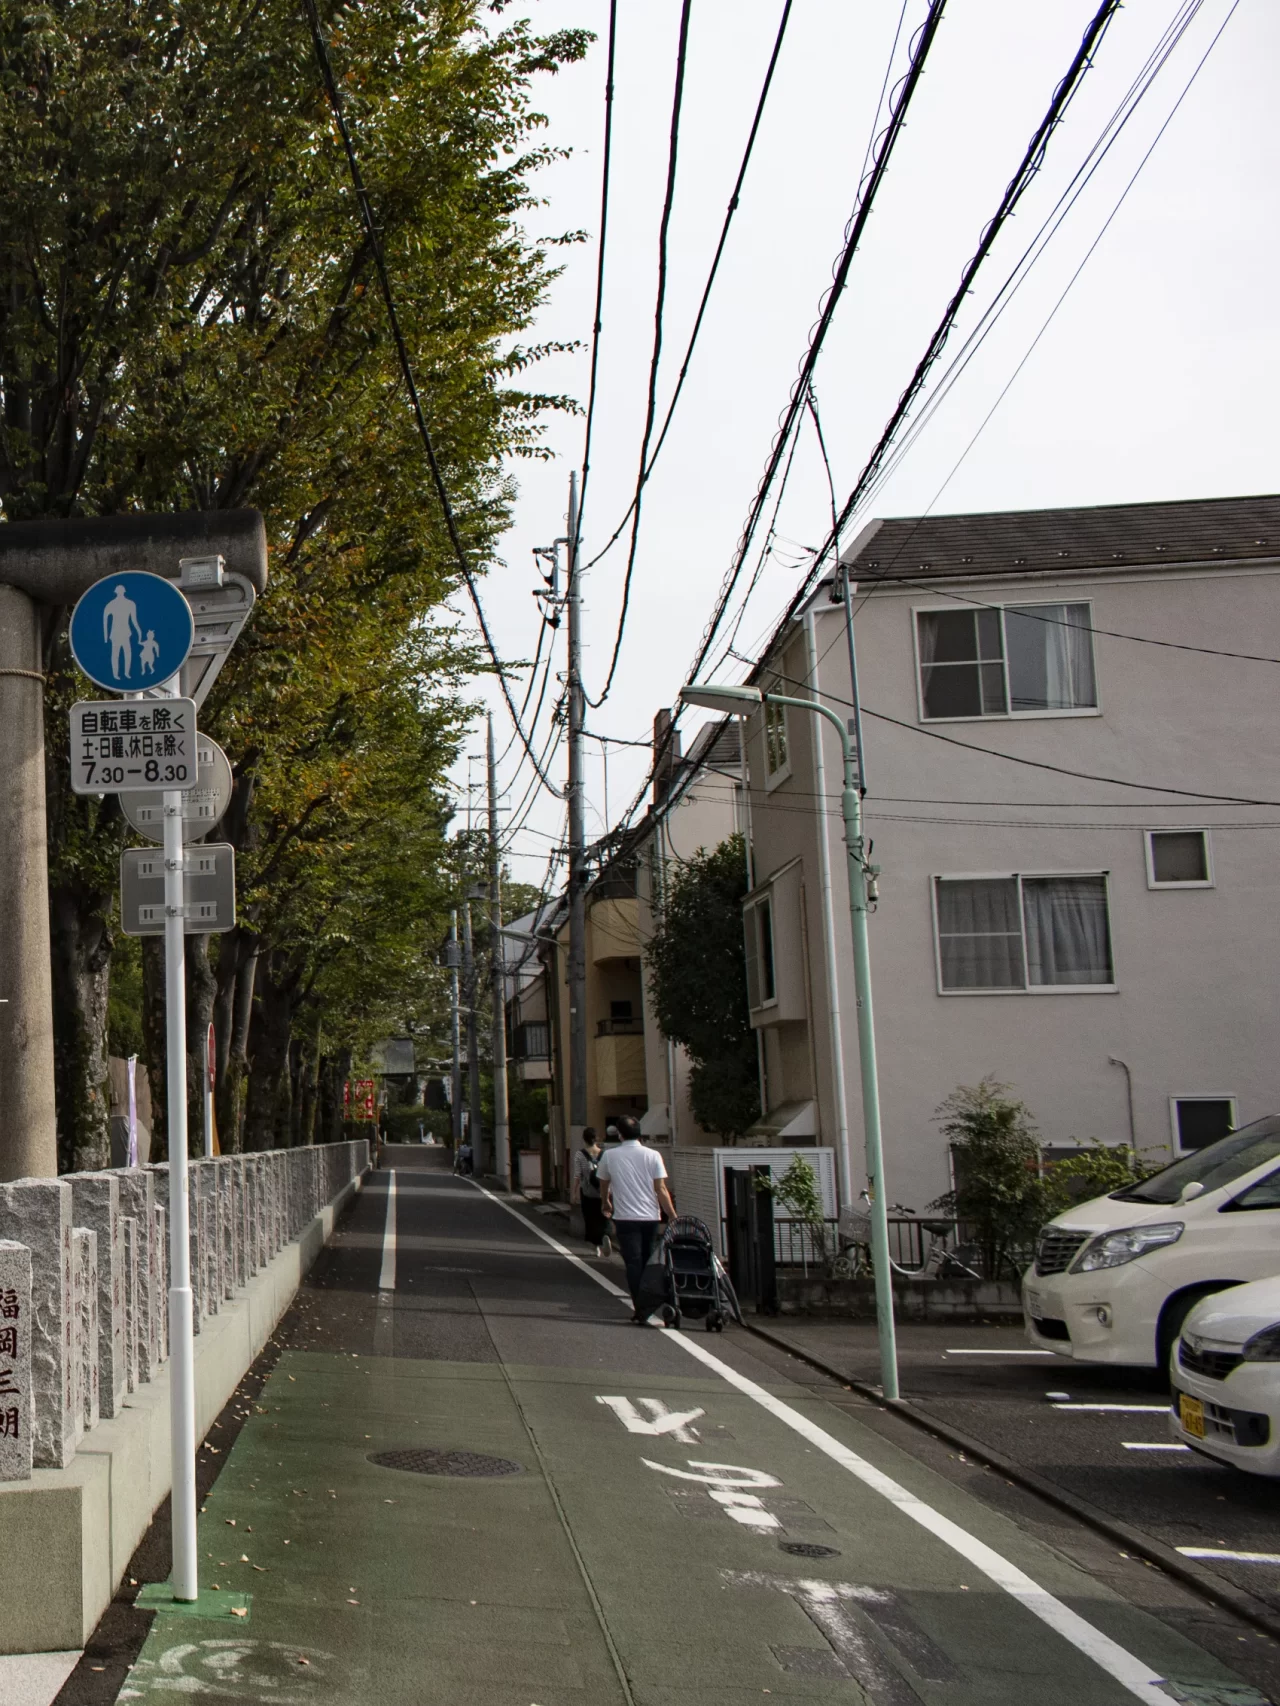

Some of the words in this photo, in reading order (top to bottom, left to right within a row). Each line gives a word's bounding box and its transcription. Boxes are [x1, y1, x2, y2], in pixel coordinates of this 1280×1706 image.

[81, 708, 185, 733] 自転車を除く
